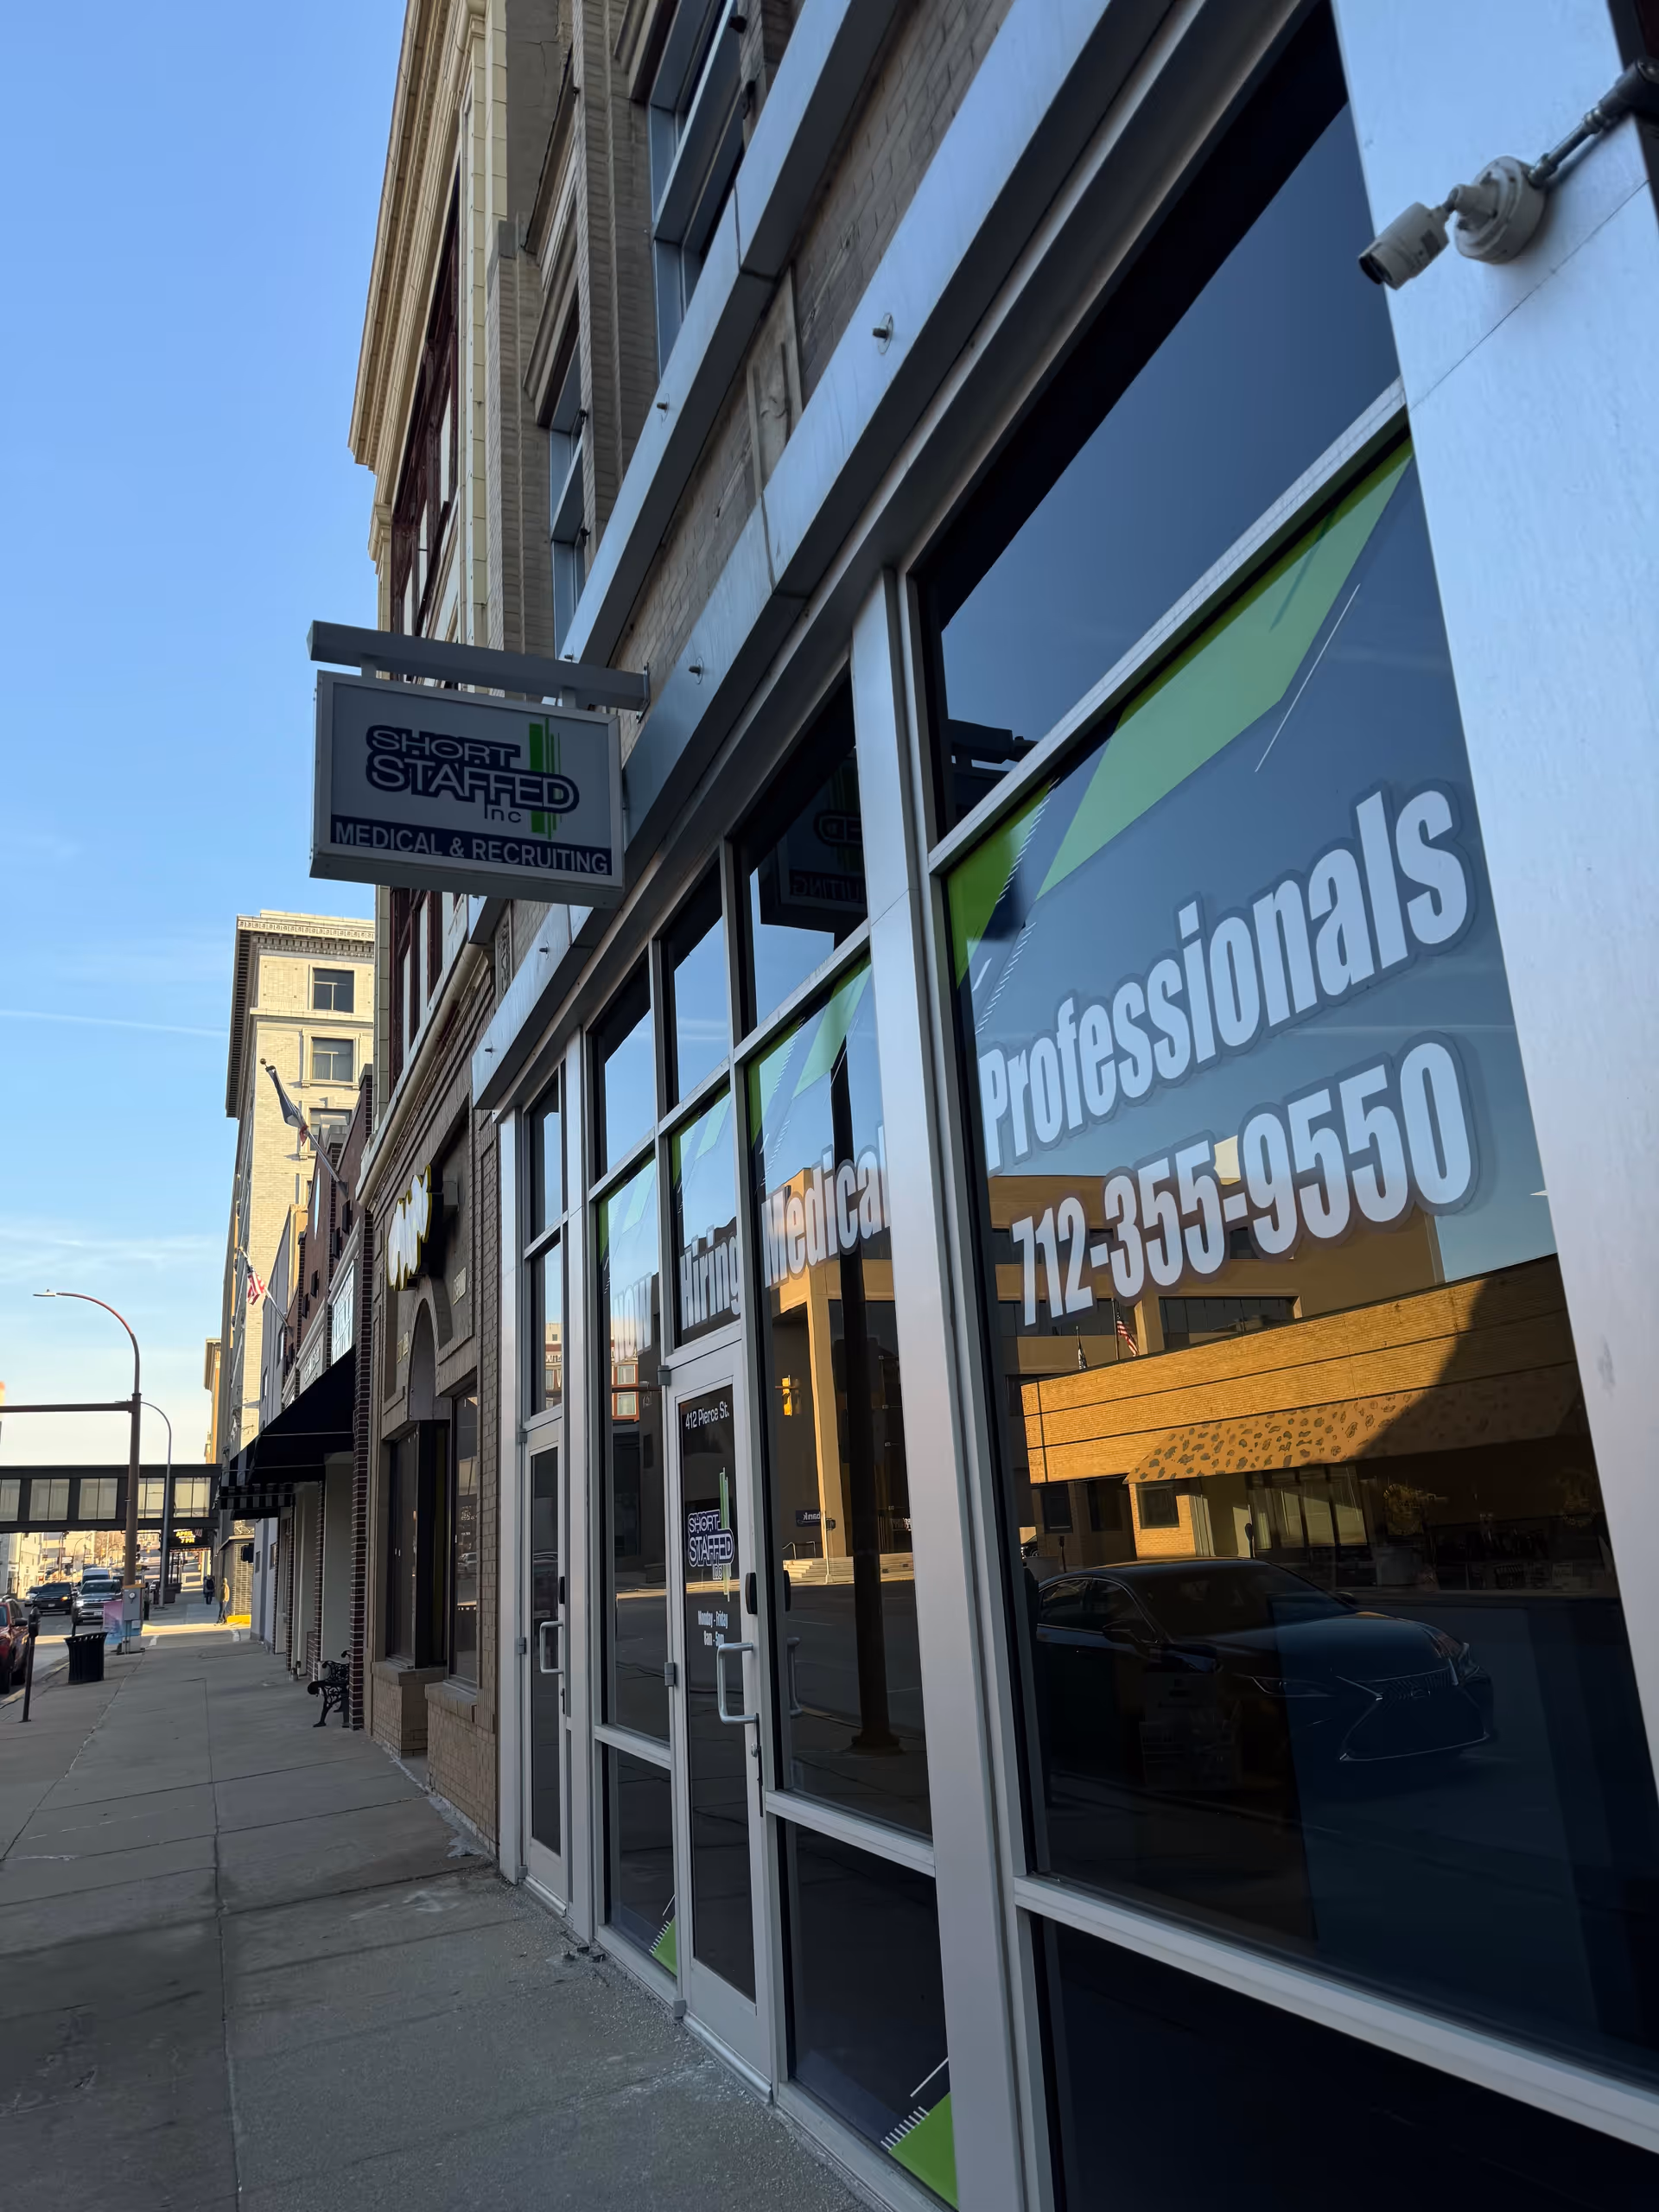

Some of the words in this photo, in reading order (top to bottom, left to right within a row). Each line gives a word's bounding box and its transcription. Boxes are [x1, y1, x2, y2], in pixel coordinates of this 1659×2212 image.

[371, 728, 515, 766] SHORT
[372, 755, 575, 809] STAFFED
[484, 804, 522, 823] Inc
[335, 821, 442, 857] MEDICAL
[448, 836, 465, 858] &
[472, 838, 609, 874] RECRUITING
[679, 1226, 741, 1331] Hiring
[760, 1125, 891, 1288] Medical
[979, 789, 1468, 1172] Professionals
[1011, 1041, 1472, 1327] 712-355-9550
[685, 1410, 697, 1430] 412
[697, 1408, 719, 1427] Pierce
[719, 1401, 729, 1419] St.
[689, 1514, 718, 1533] SHORT
[689, 1534, 733, 1561] STAFFED
[697, 1610, 713, 1628] Monday
[715, 1610, 728, 1630] Friday
